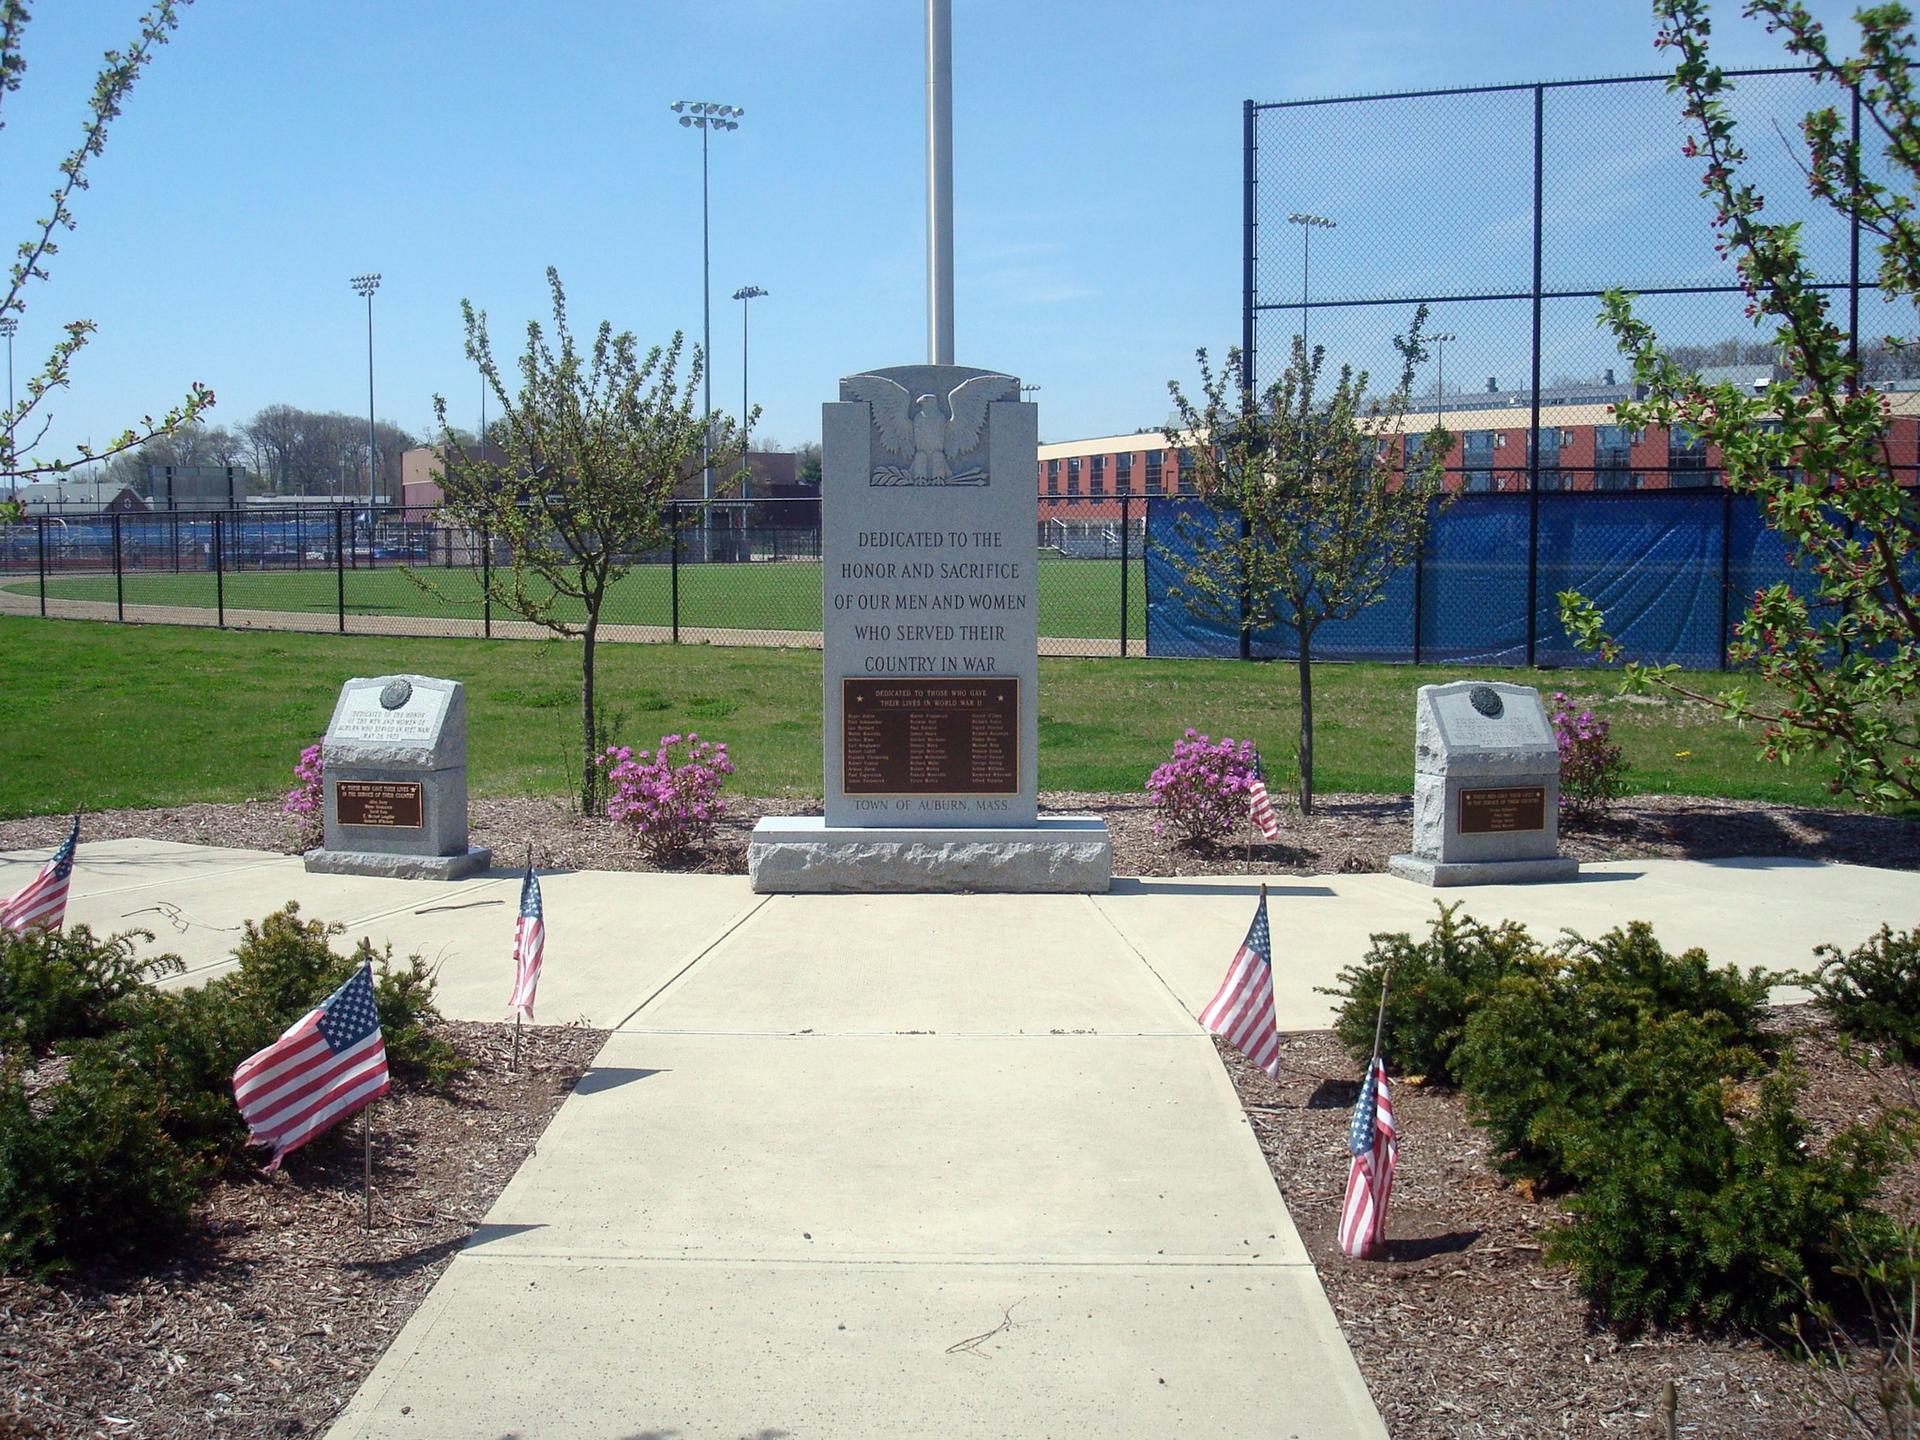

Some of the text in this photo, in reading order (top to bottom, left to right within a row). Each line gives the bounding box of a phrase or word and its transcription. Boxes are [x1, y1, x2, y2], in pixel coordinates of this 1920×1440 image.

[858, 531, 1002, 548] DEDICATED TO THE
[842, 563, 1020, 579] HONOR AND SACRIFICE
[834, 594, 1026, 610] OF OUR MEN AND WOMEN
[855, 625, 1006, 641] WHO SERVED THEIR
[864, 656, 997, 672] COUNTRY IN WAR
[854, 800, 889, 811] TOWN
[896, 800, 912, 811] OF
[918, 800, 970, 813] AUBURN,
